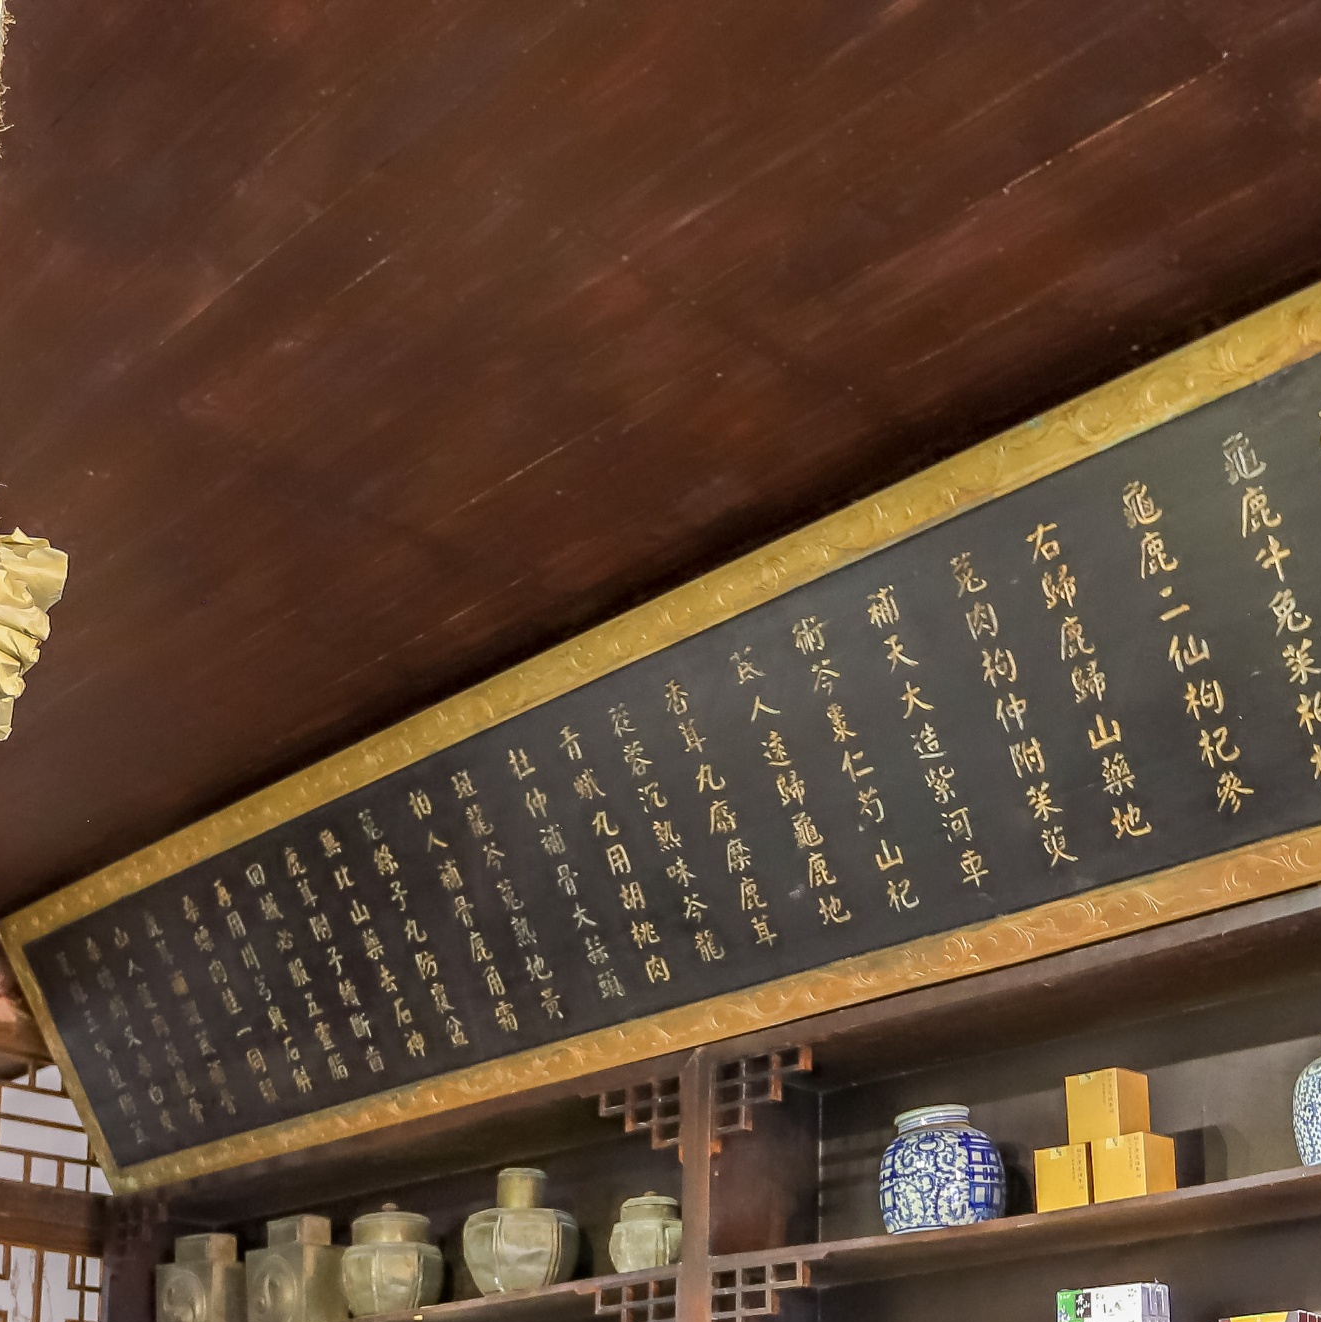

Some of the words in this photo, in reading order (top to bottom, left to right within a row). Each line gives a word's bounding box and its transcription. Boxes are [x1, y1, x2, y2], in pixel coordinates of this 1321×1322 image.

[866, 584, 990, 889] 補天大造紫河車
[1024, 522, 1153, 840] 右歸鹿歸山藥地
